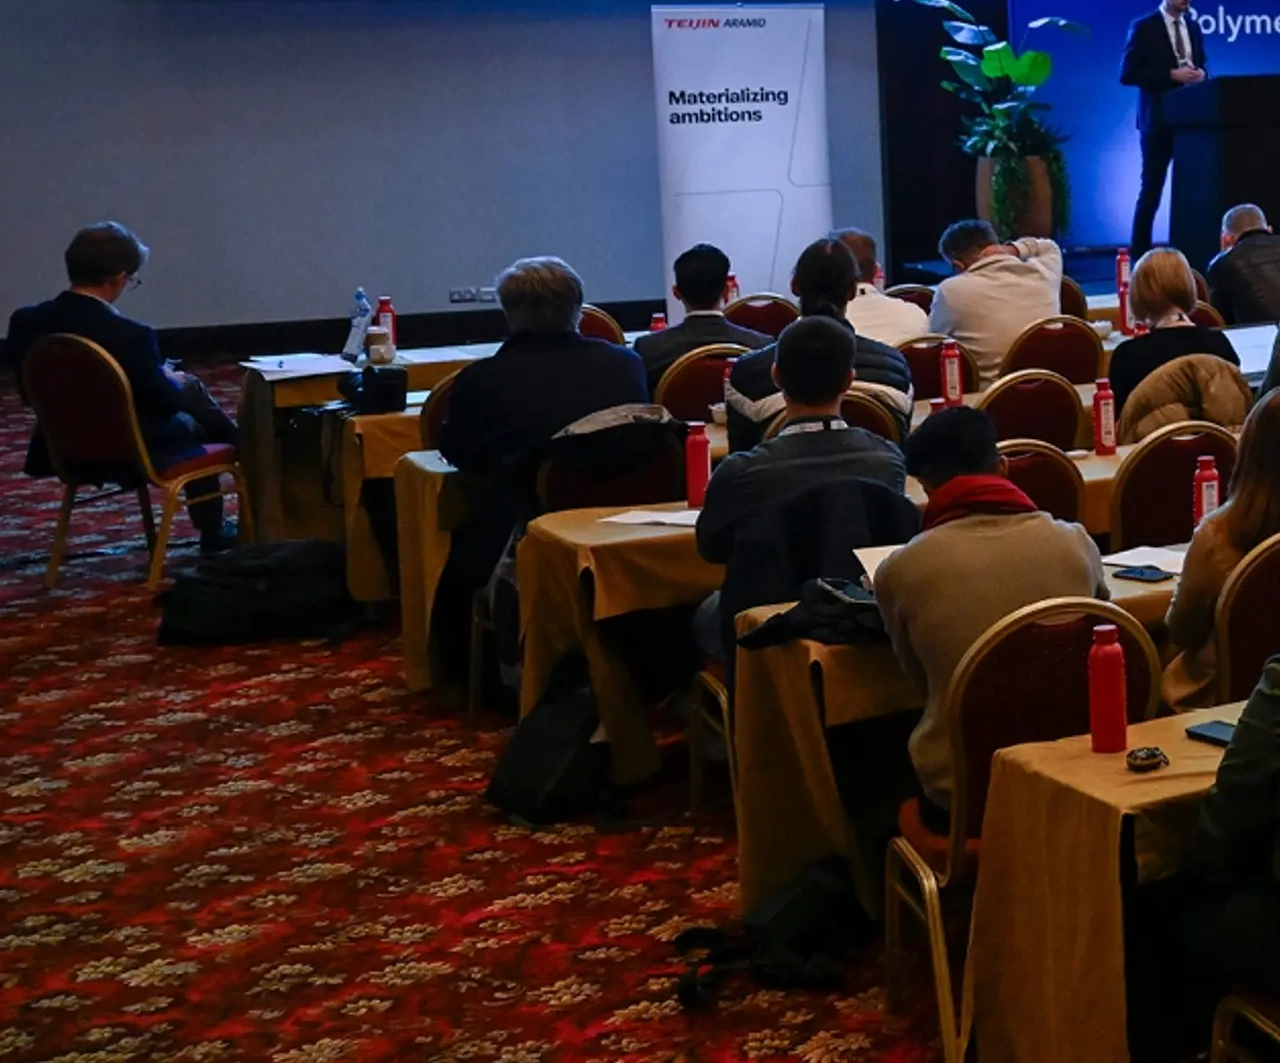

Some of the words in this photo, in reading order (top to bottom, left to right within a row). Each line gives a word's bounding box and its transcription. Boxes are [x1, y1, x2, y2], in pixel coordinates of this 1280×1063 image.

[664, 18, 720, 30] TEIJIN
[723, 18, 766, 29] ARAMID
[668, 87, 789, 106] Materializing
[669, 107, 763, 125] ambitions
